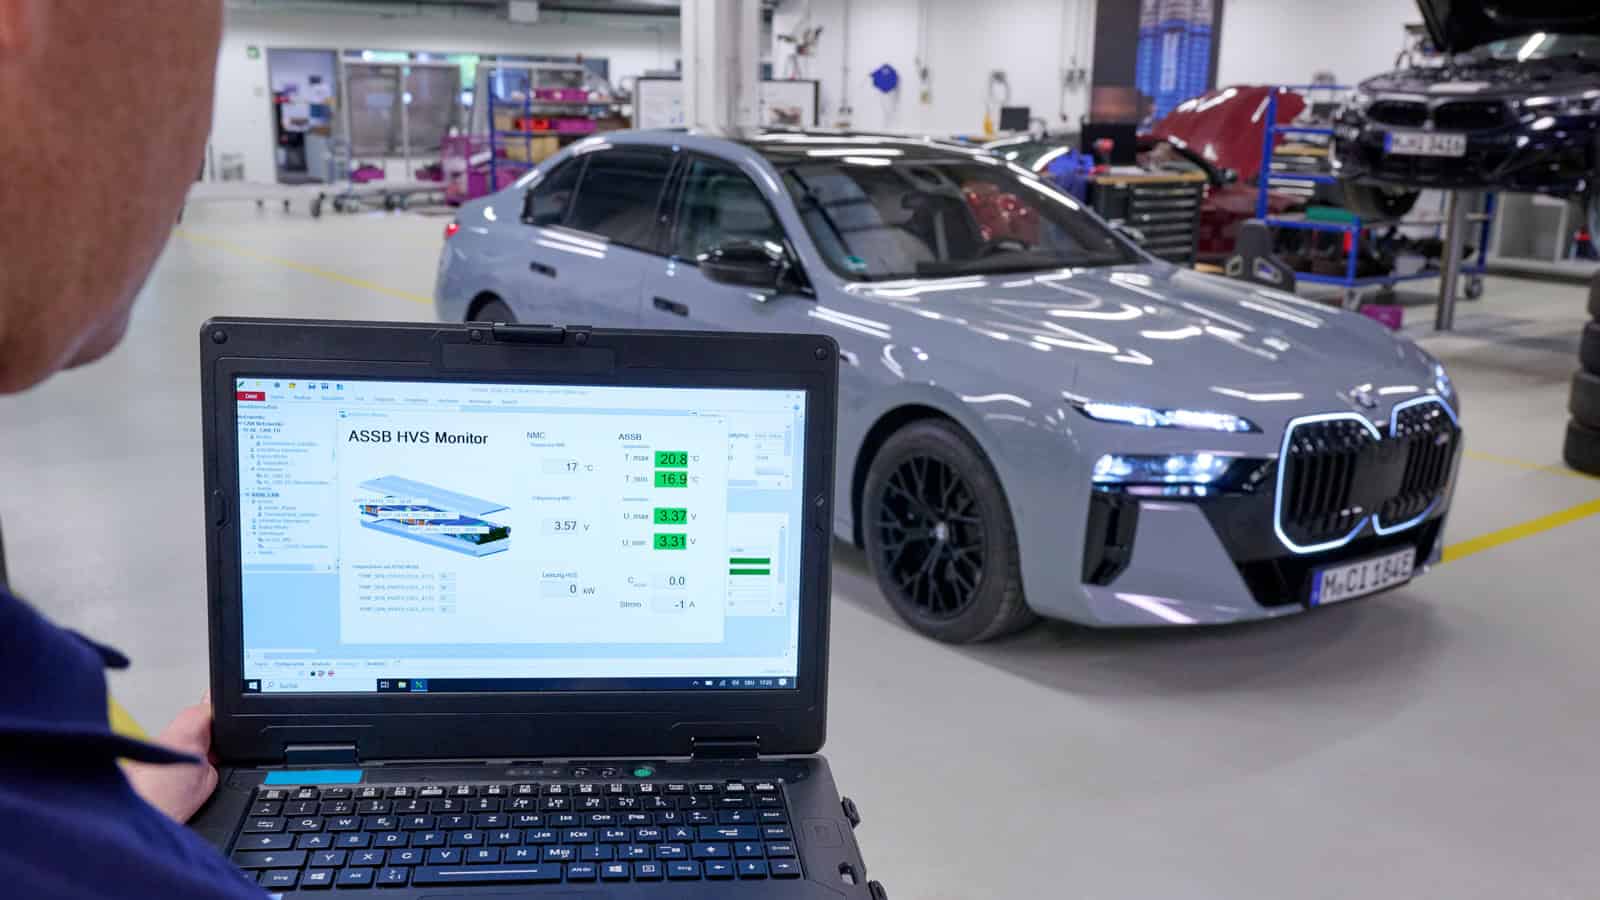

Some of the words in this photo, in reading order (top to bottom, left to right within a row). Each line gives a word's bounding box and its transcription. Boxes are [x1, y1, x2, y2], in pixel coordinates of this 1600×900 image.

[348, 430, 392, 443] ASSB
[397, 431, 430, 444] HVS
[435, 431, 489, 445] Monitor
[526, 431, 545, 440] NMC
[618, 432, 642, 441] ASSB
[660, 453, 688, 465] 20.8
[566, 461, 577, 472] 17
[661, 472, 688, 485] 16.9
[660, 509, 688, 522] 3.37
[554, 520, 577, 531] 3.57
[659, 534, 686, 547] 3.31
[668, 575, 686, 586] 0.0
[569, 583, 577, 594] 0
[674, 599, 684, 609] -1
